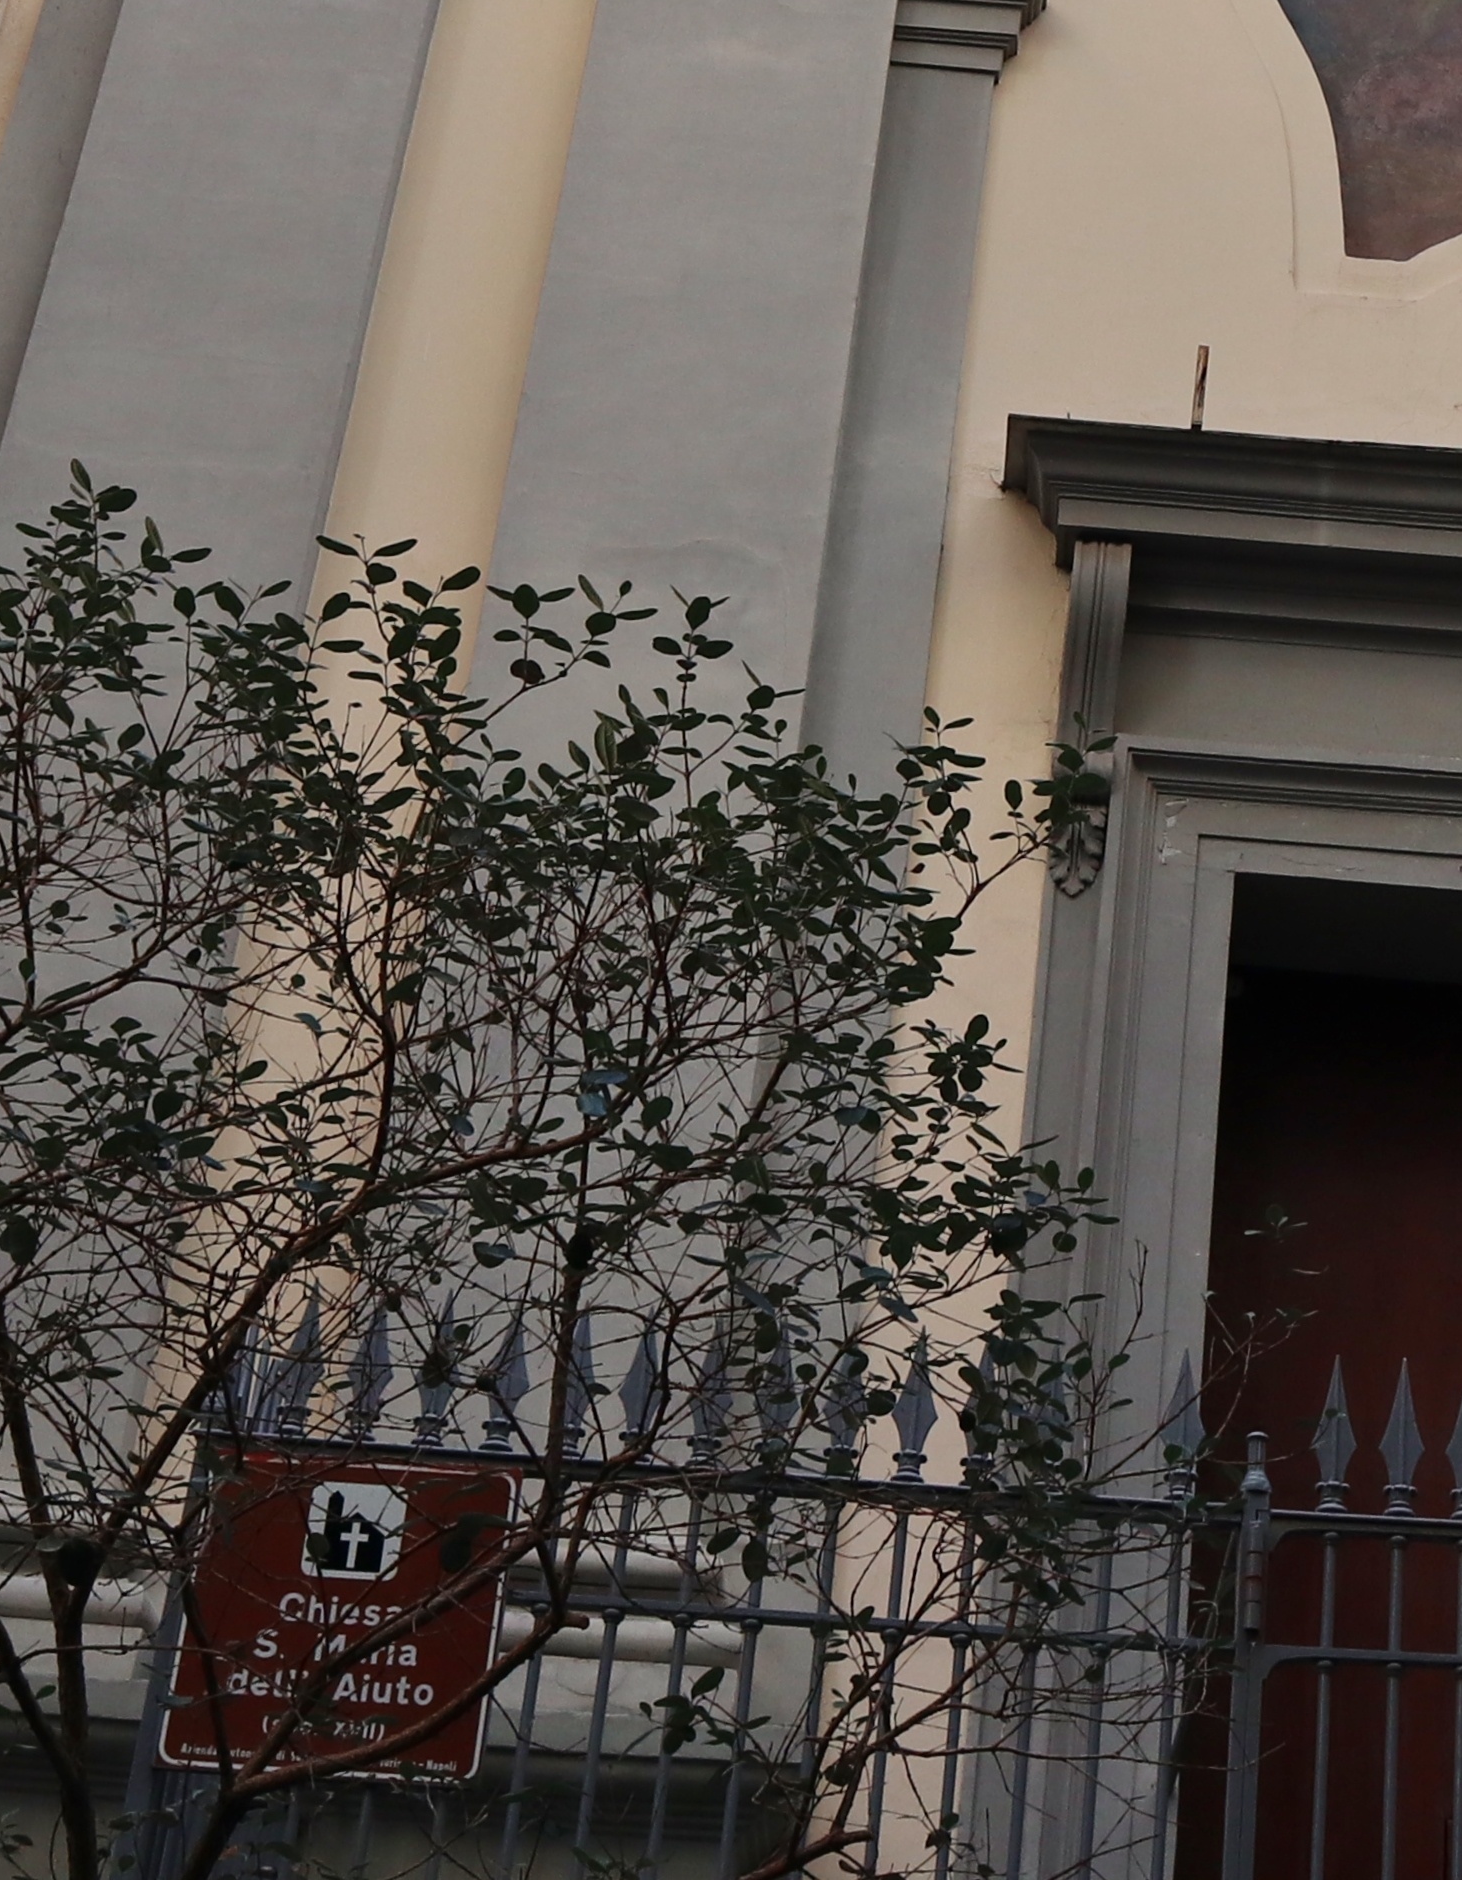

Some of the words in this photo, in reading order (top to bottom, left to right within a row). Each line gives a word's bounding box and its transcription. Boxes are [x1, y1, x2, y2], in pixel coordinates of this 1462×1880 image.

[253, 1628, 284, 1659] S.
[313, 1632, 418, 1667] Mria
[332, 1672, 435, 1706] Aiuto
